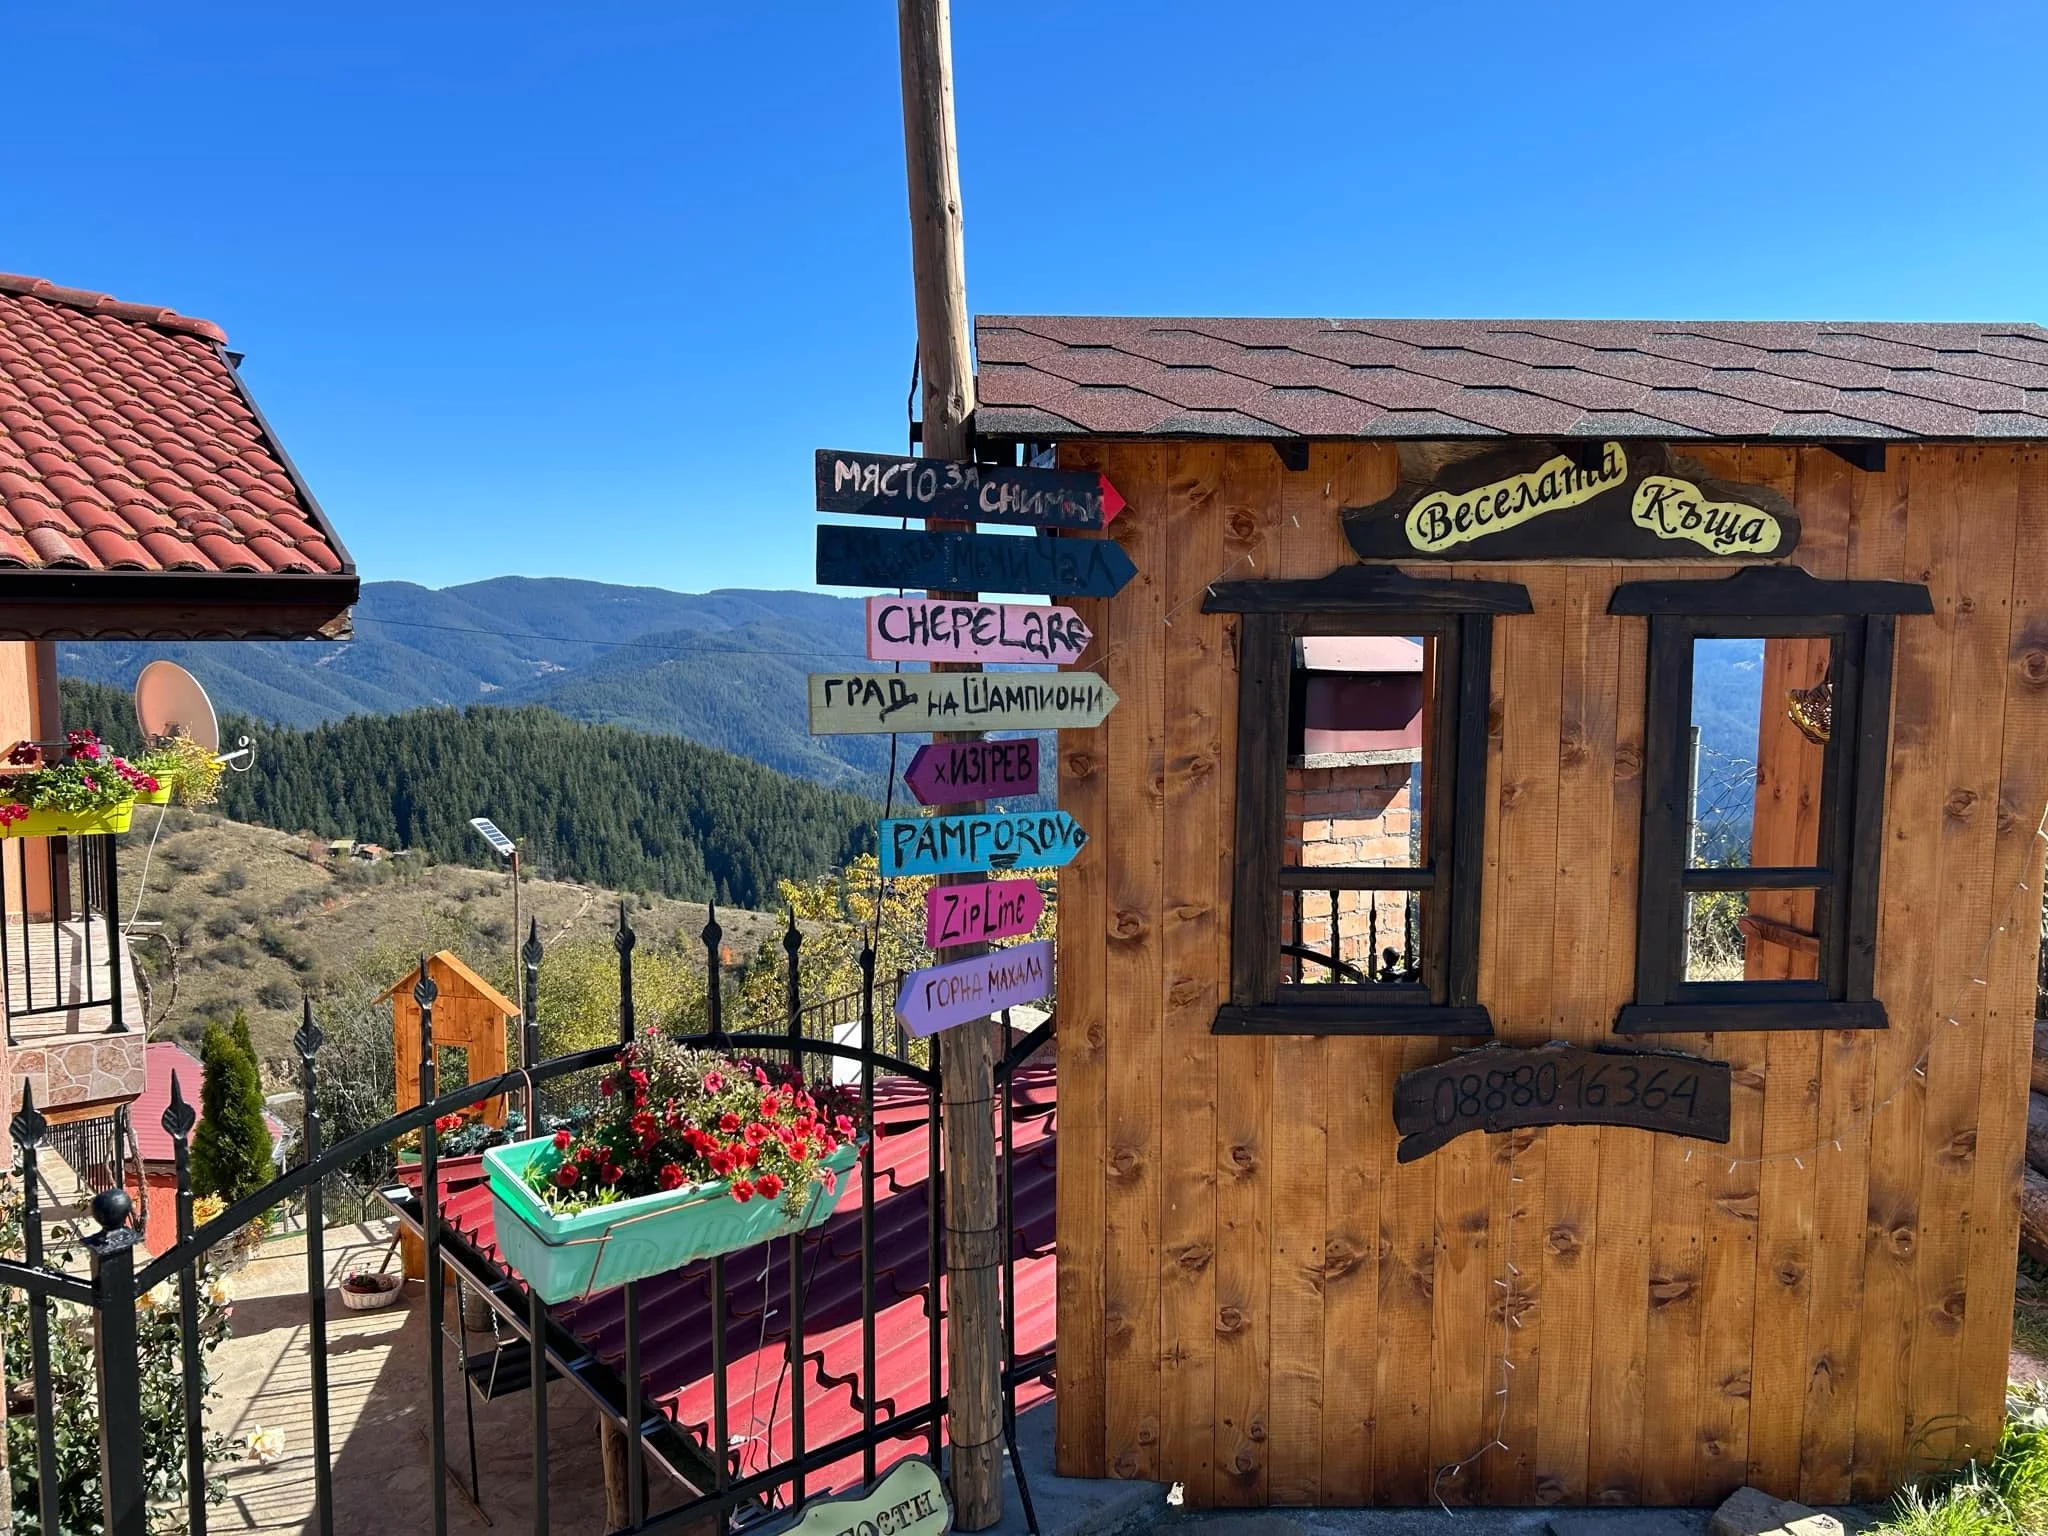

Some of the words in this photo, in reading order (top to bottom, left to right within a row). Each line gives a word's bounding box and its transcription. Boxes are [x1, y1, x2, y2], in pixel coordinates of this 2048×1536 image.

[834, 458, 938, 503] МЯСТО
[943, 460, 981, 491] ЗА
[1643, 484, 1763, 548] Къща
[824, 677, 919, 723] ГРАД
[962, 676, 1105, 714] ШАМПИОНИ
[925, 972, 984, 1013] ГОРНА
